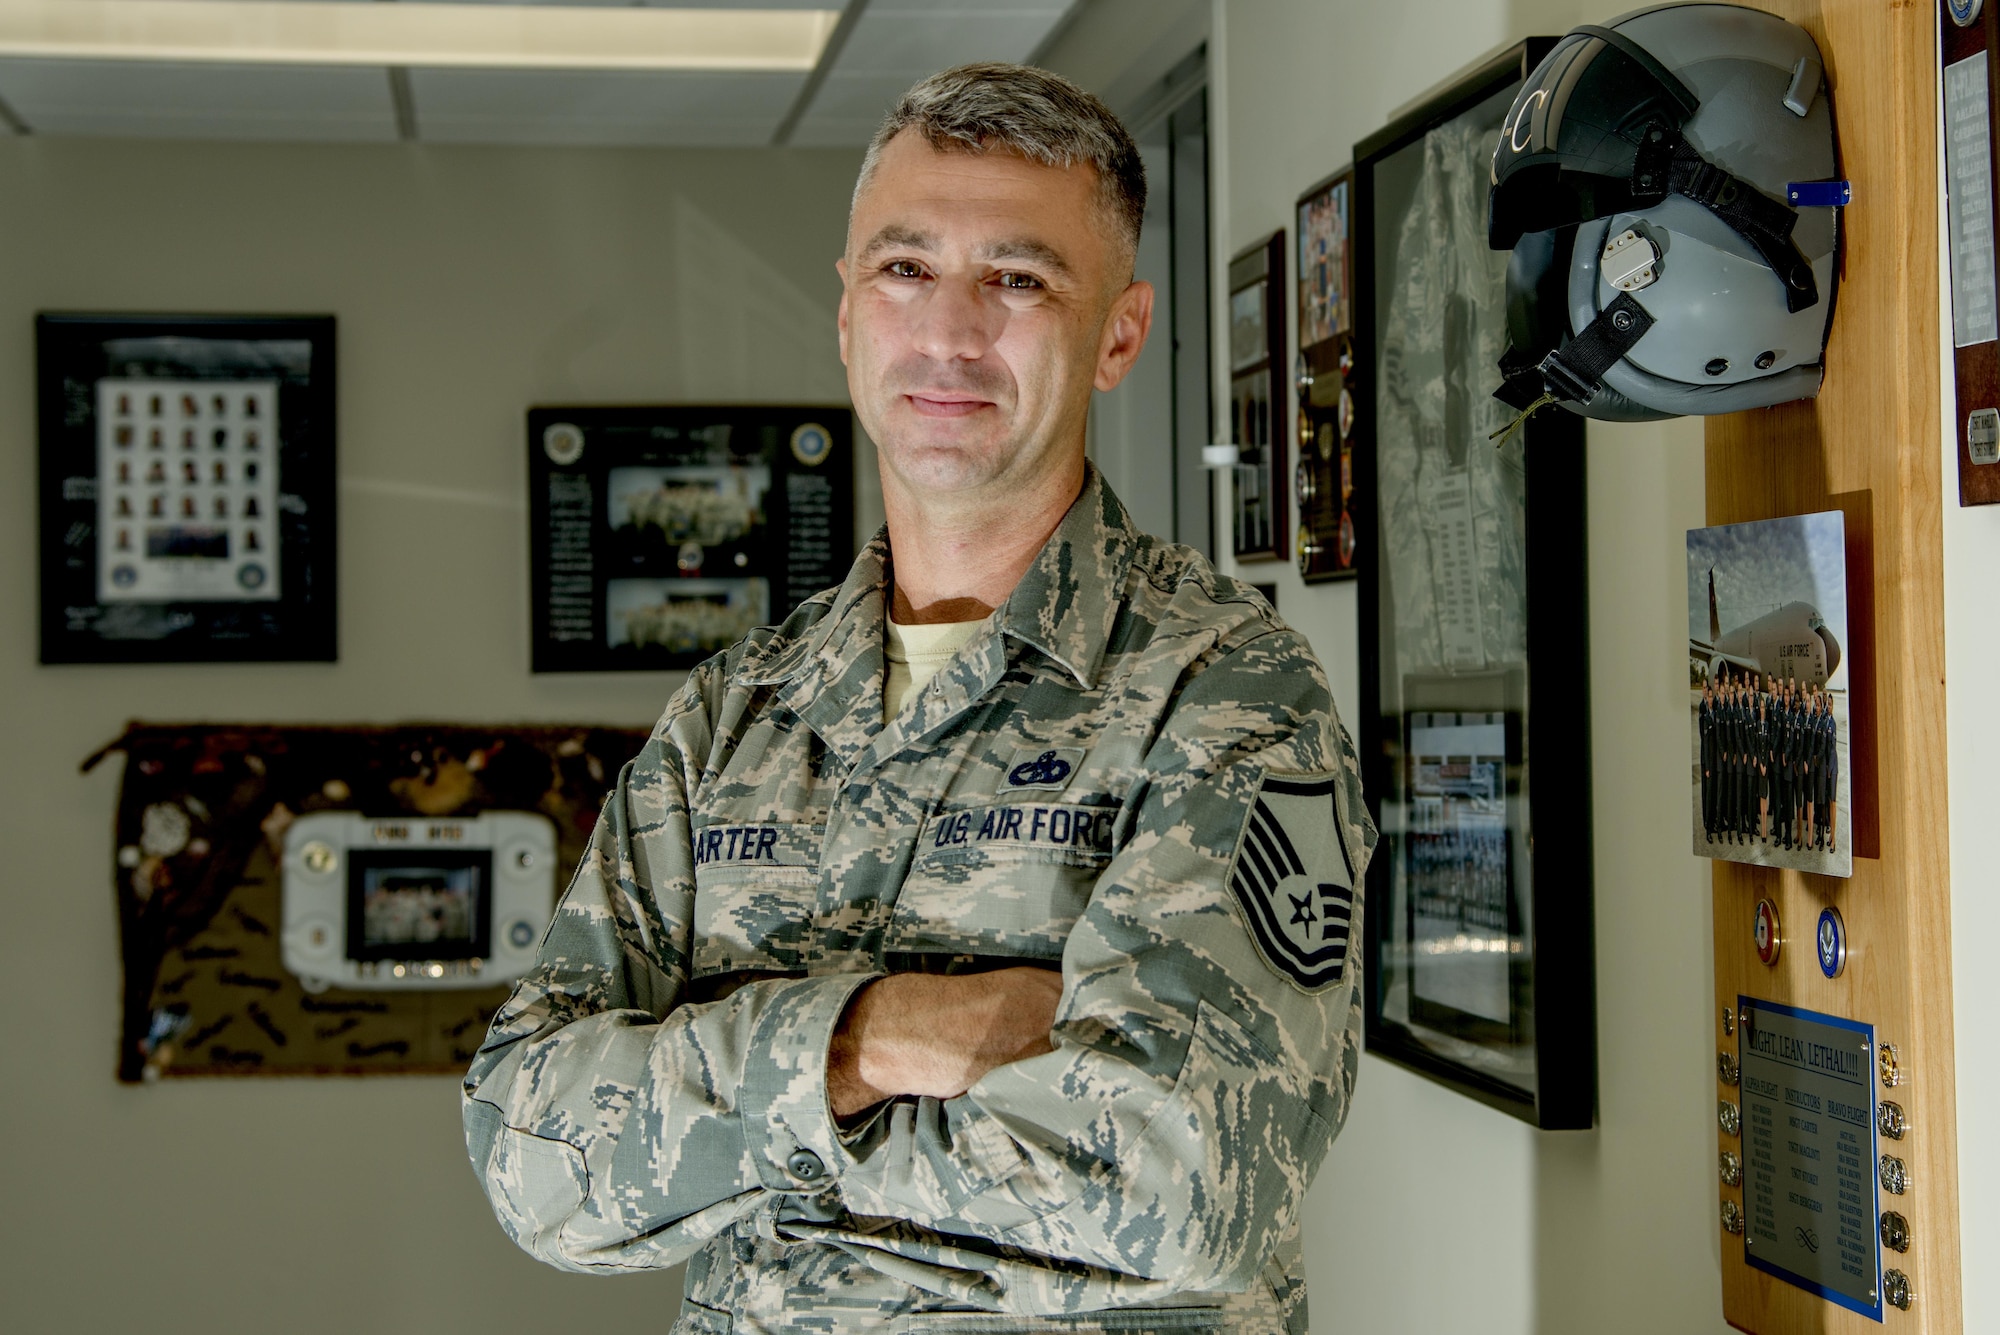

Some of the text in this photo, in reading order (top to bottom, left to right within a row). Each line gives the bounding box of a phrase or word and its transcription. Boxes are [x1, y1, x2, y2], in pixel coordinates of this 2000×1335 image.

[1794, 644, 1810, 657] FORCE
[935, 808, 1117, 847] U.S. AIR FORC
[692, 828, 777, 867] ARTER
[1780, 1035, 1806, 1067] LEAN,
[1808, 1042, 1859, 1077] LETHAL!!!!
[1745, 1076, 1778, 1097] ALPHA FLIGHT
[1784, 1087, 1821, 1110] INSTRUCTORS
[1828, 1100, 1868, 1124] BRAVO FLIGHT
[1801, 1119, 1818, 1134] CARTER
[1788, 1141, 1798, 1154] TSGT
[1791, 1167, 1800, 1180] TSGT
